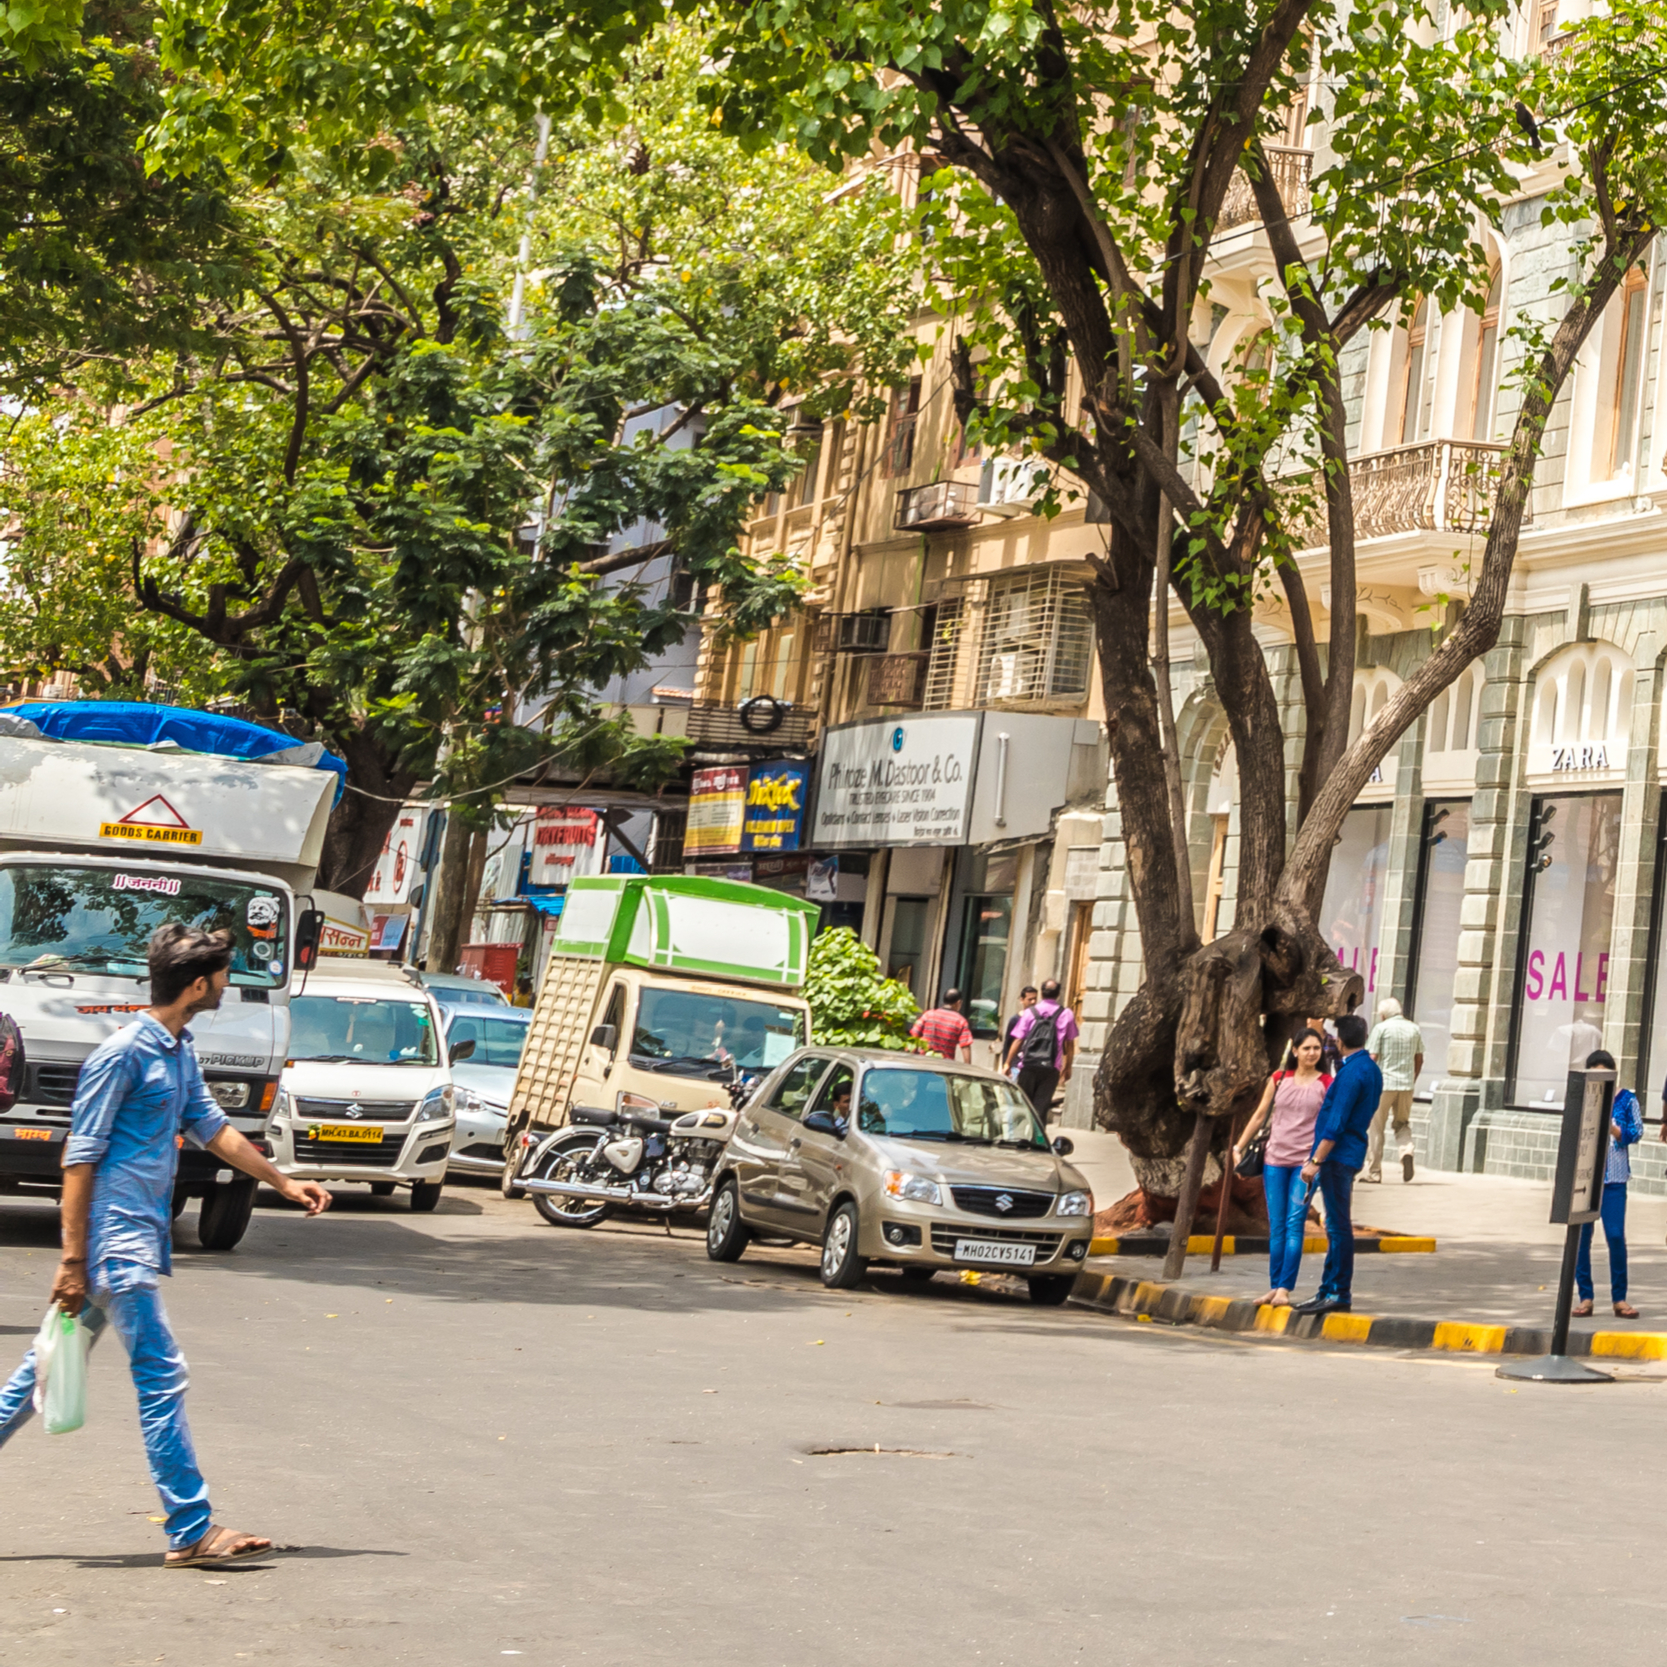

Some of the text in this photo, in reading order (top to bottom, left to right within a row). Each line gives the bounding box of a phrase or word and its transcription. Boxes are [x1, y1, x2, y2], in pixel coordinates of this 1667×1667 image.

[1552, 745, 1610, 771] ZARA
[885, 759, 930, 787] Dastoor
[932, 754, 941, 784] &
[945, 754, 962, 784] Co.
[104, 825, 198, 843] GOODS CARRIER
[1526, 950, 1610, 1002] SALE
[211, 1053, 265, 1067] PICKUP
[962, 1244, 1034, 1262] MH02CY5141
